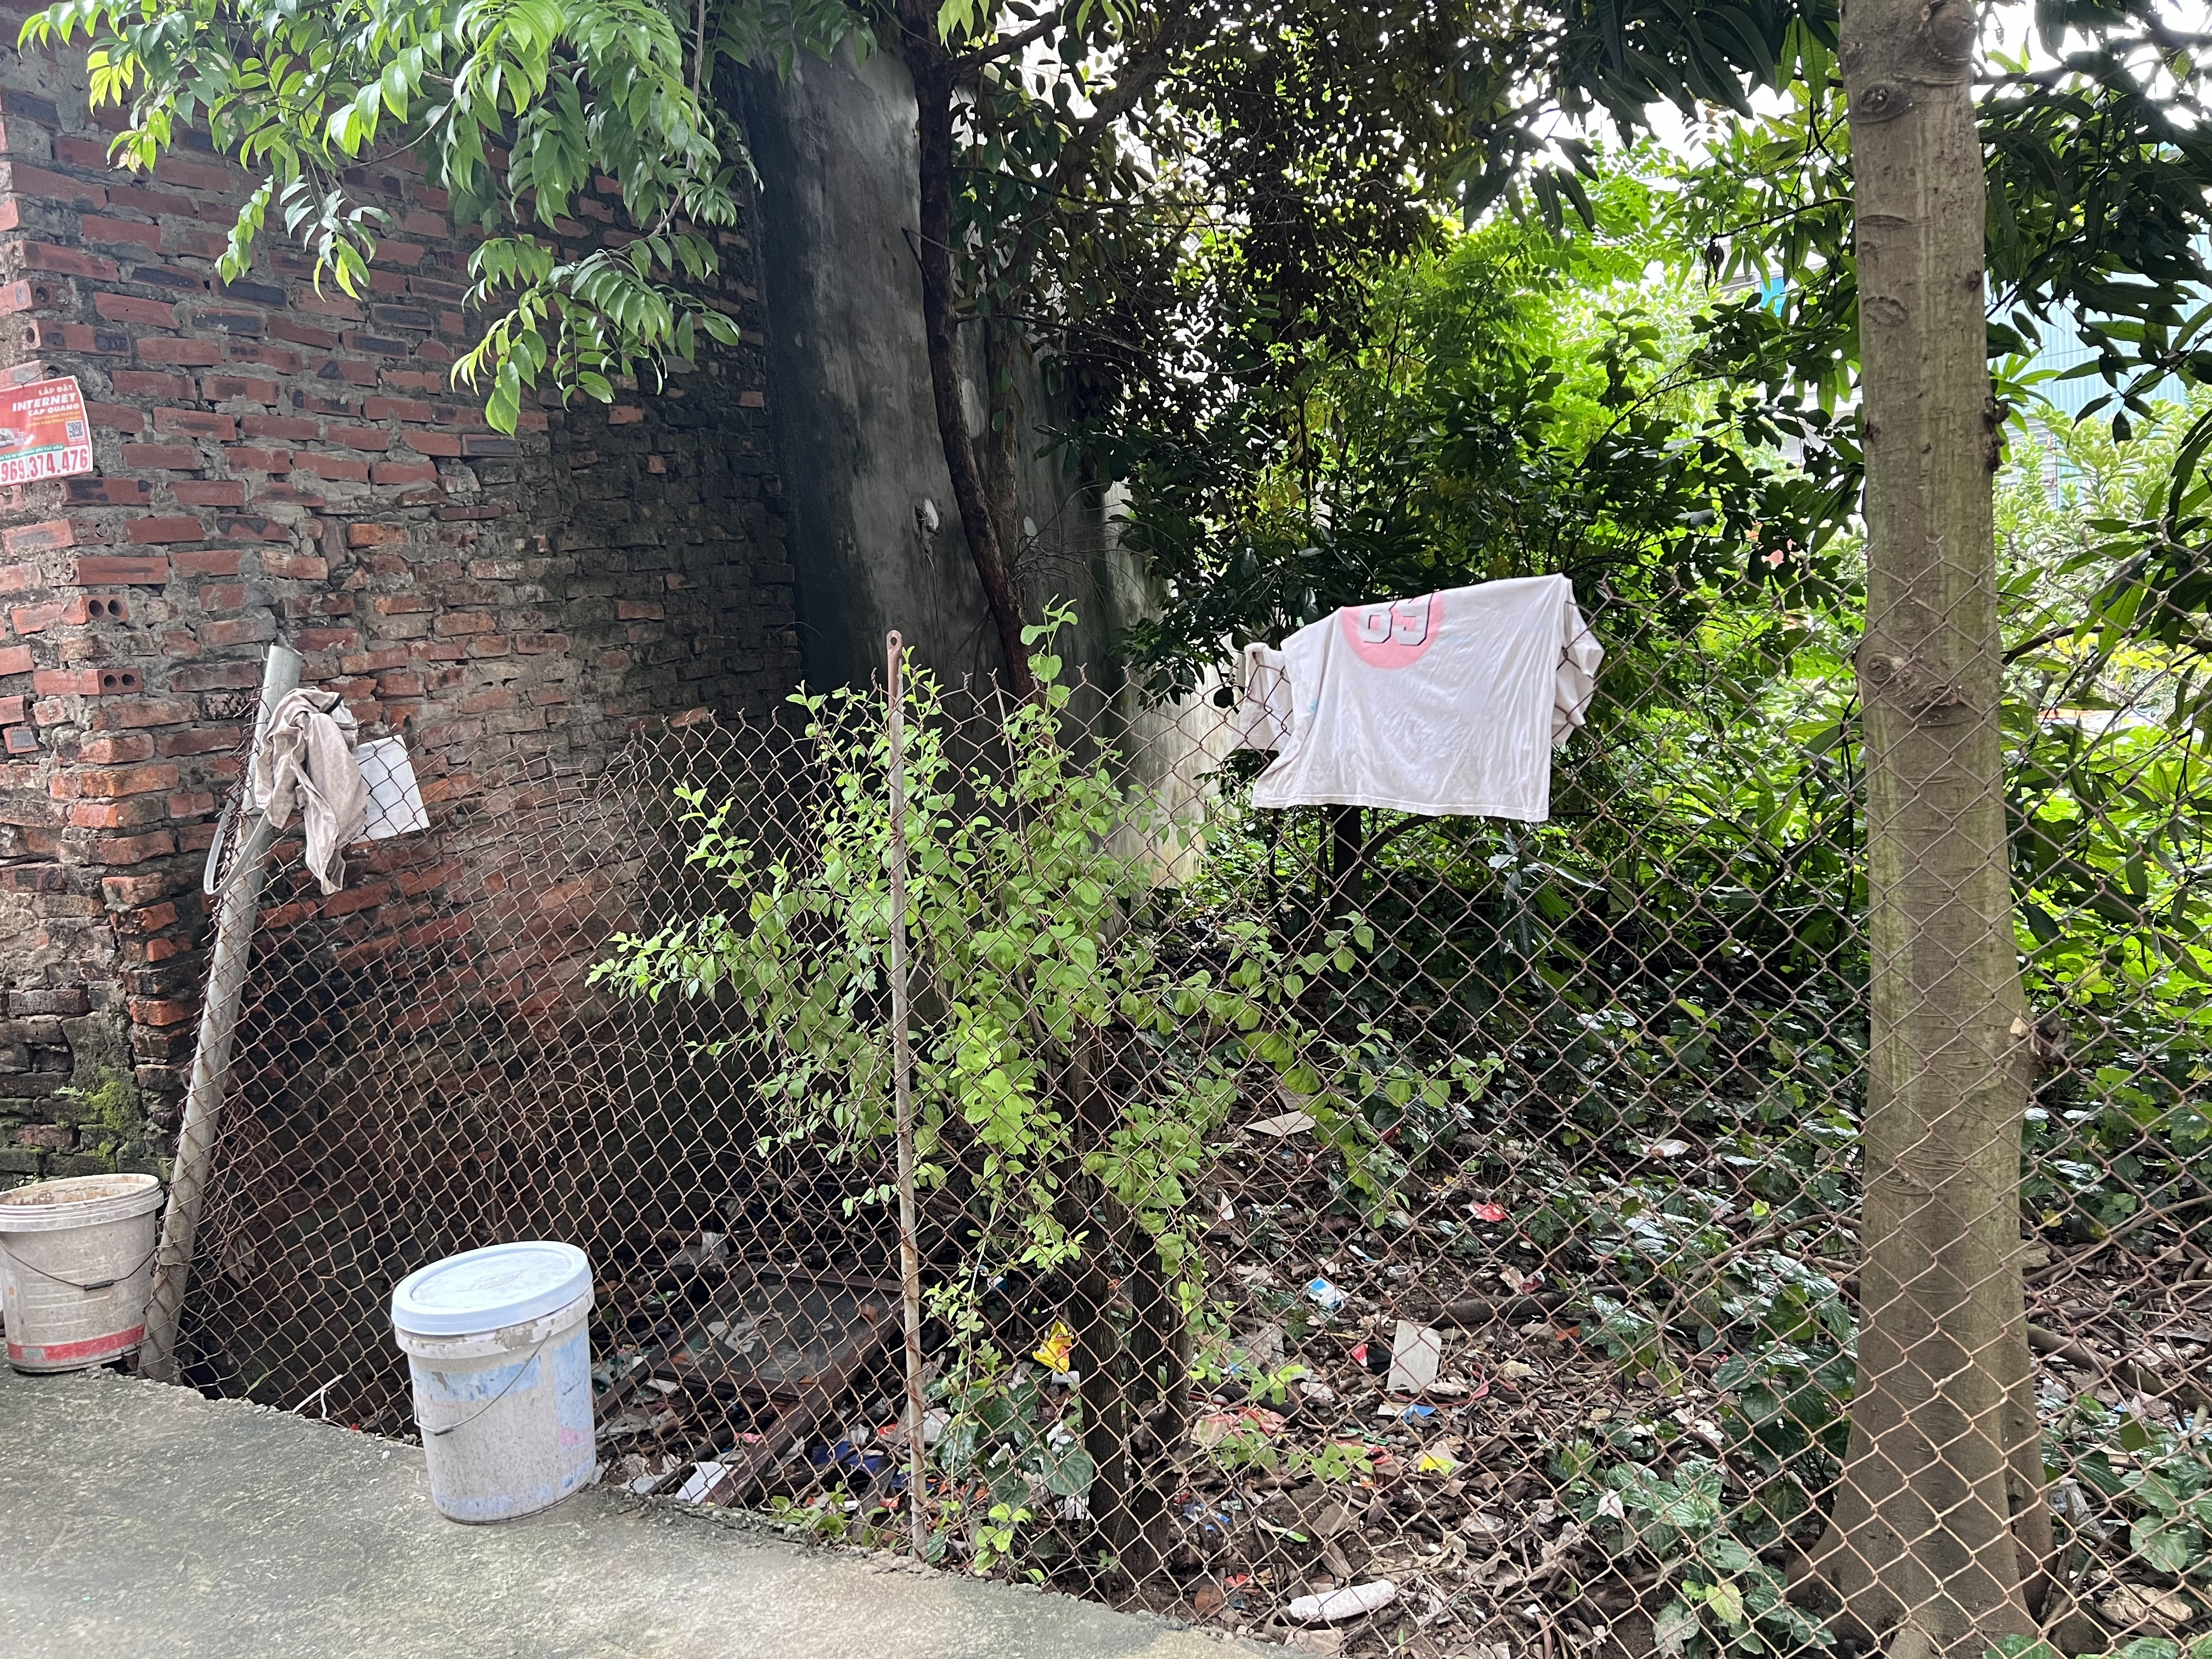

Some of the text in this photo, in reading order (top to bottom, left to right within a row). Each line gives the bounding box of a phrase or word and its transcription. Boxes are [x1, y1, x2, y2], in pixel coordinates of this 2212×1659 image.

[13, 393, 76, 412] INTERNET
[47, 403, 80, 413] QUANG
[1, 448, 88, 482] 969.374.476
